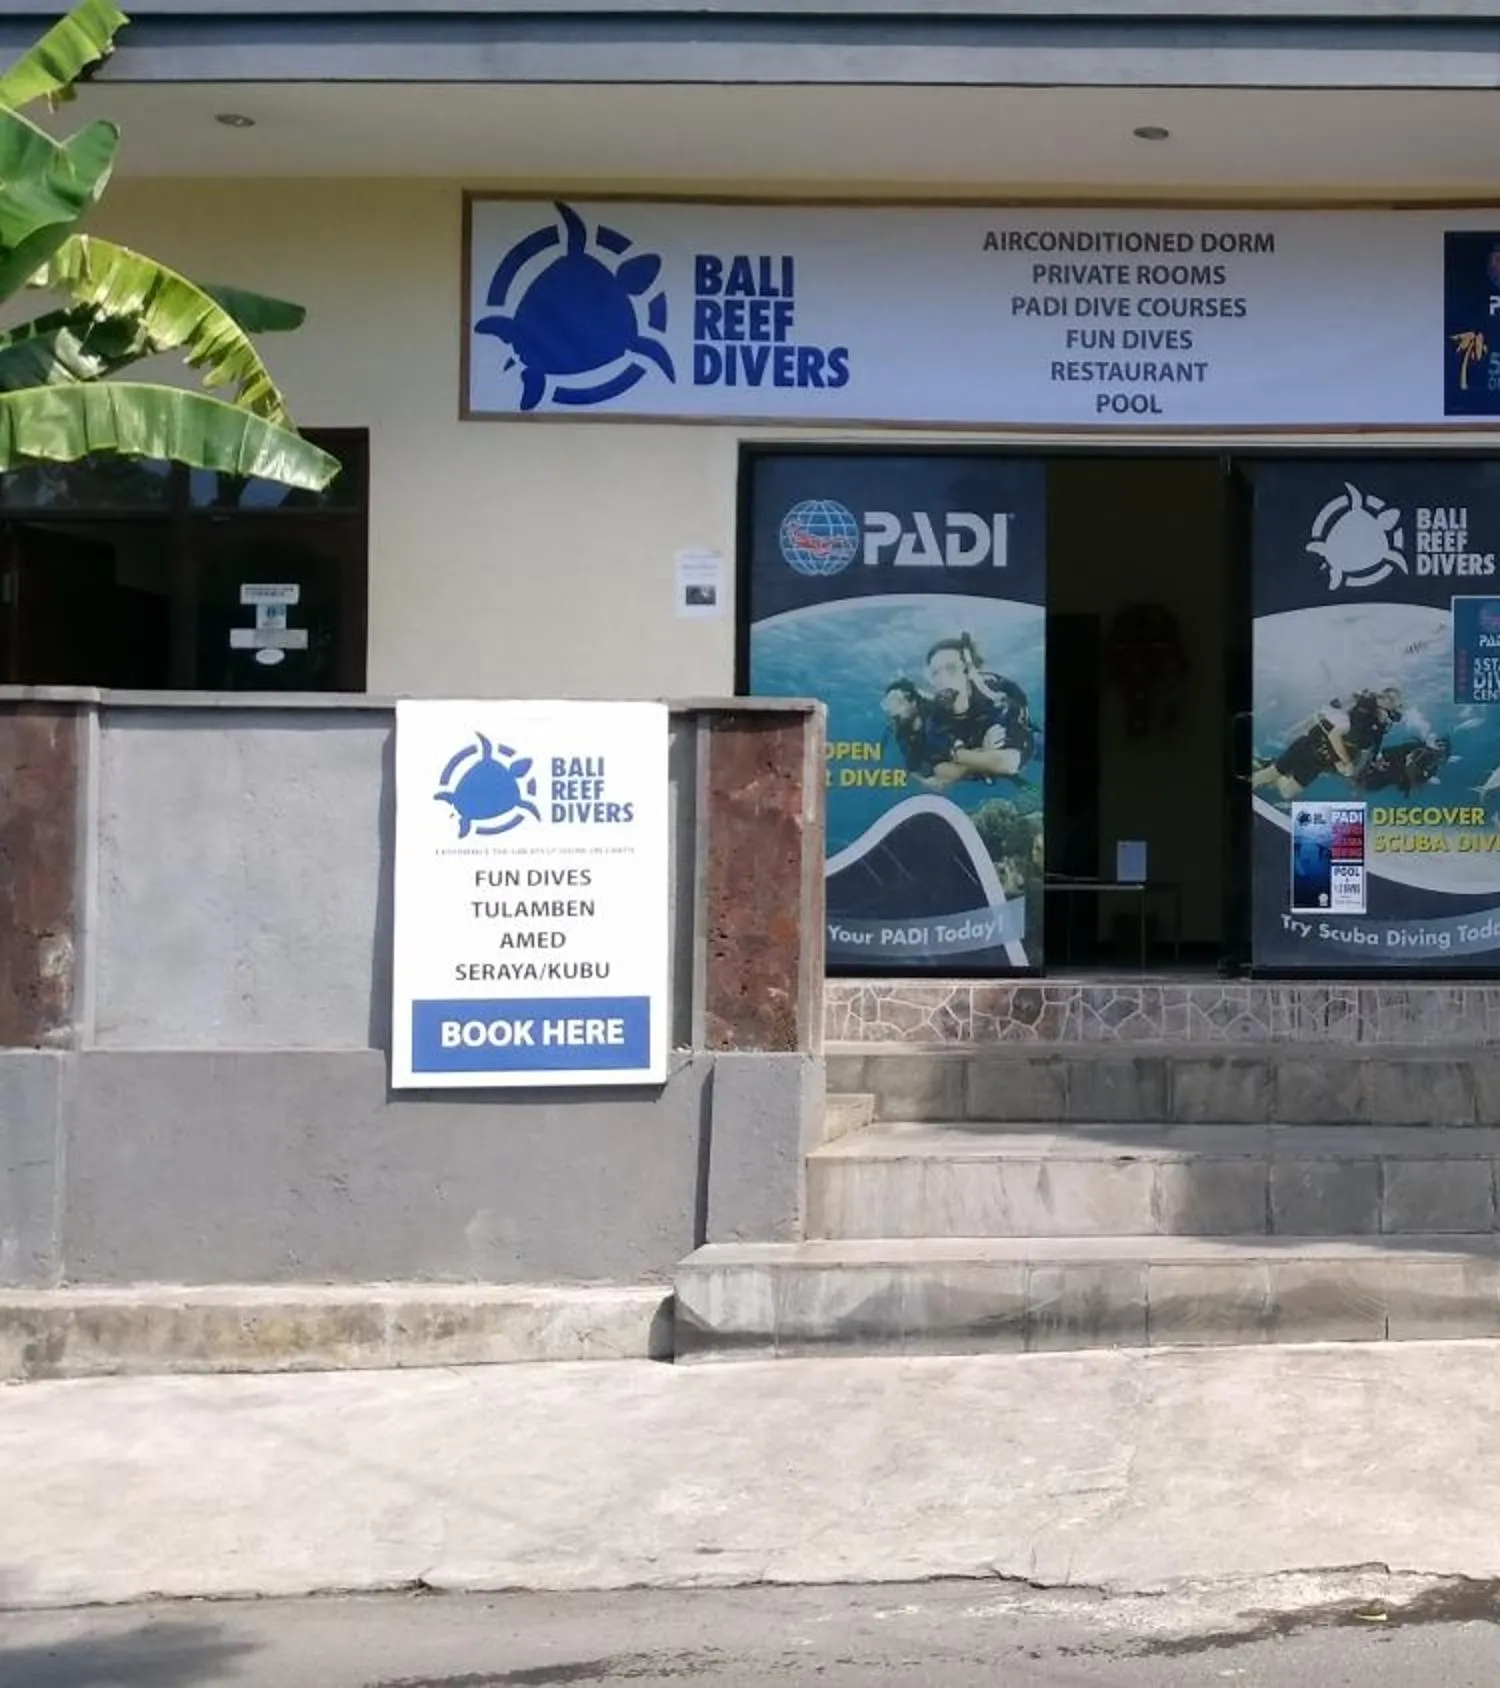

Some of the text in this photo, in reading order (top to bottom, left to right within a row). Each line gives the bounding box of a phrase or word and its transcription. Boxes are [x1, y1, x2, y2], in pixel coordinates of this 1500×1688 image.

[983, 231, 1276, 253] AIRCONDITIONED DORM
[695, 255, 794, 297] BALI
[1032, 264, 1226, 286] PRIVATE ROOMS
[1011, 296, 1247, 318] PADI DIVE COURSES
[694, 300, 795, 341] REEF
[1066, 329, 1193, 350] FUN DIVES
[693, 345, 850, 388] DIVERS
[1051, 361, 1208, 382] RESTAURANT
[1488, 353, 1500, 375] 5
[1096, 394, 1163, 415] POOL
[1416, 507, 1468, 531] BALI
[863, 511, 1010, 567] PADI
[1416, 531, 1469, 553] REEF
[1416, 554, 1496, 577] DIVERS
[551, 756, 605, 777] BALI
[840, 768, 907, 788] DIVER
[551, 779, 605, 801] REEF
[551, 802, 635, 824] DIVERS
[1373, 807, 1485, 826] DISCOVER
[1374, 834, 1449, 854] SCUBA
[474, 868, 593, 887] FUN DIVES
[471, 899, 596, 918] TULAMBEN
[499, 930, 567, 949] AMED
[828, 913, 1004, 946] Your PADI Today!
[1281, 913, 1312, 937] Try
[1319, 922, 1378, 945] Scuba
[1386, 924, 1453, 950] Diving
[454, 961, 611, 981] SERAYA/KUBU
[440, 1019, 625, 1047] BOOK HERE
